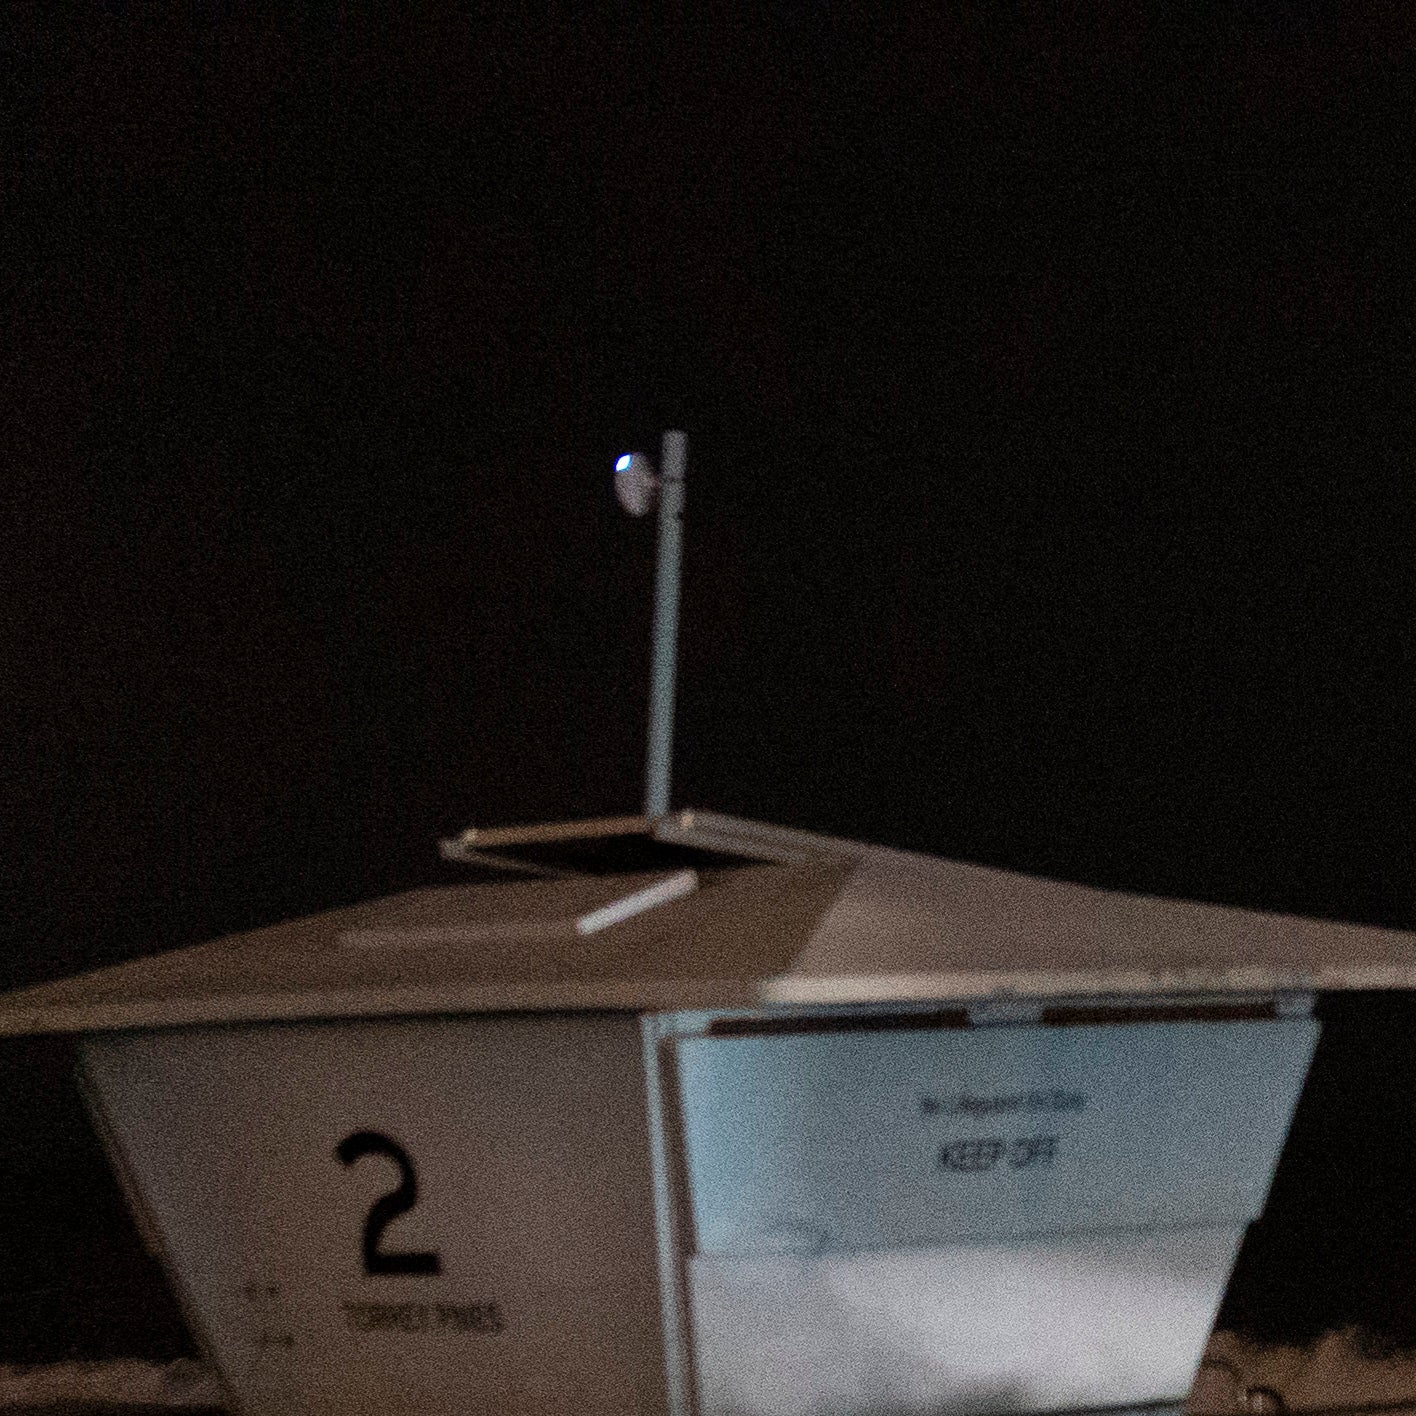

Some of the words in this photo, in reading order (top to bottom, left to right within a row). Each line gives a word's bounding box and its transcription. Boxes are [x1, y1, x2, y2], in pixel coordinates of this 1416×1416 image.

[939, 1138, 1004, 1172] KEEP
[1009, 1133, 1060, 1169] OFF
[337, 1130, 441, 1275] 2
